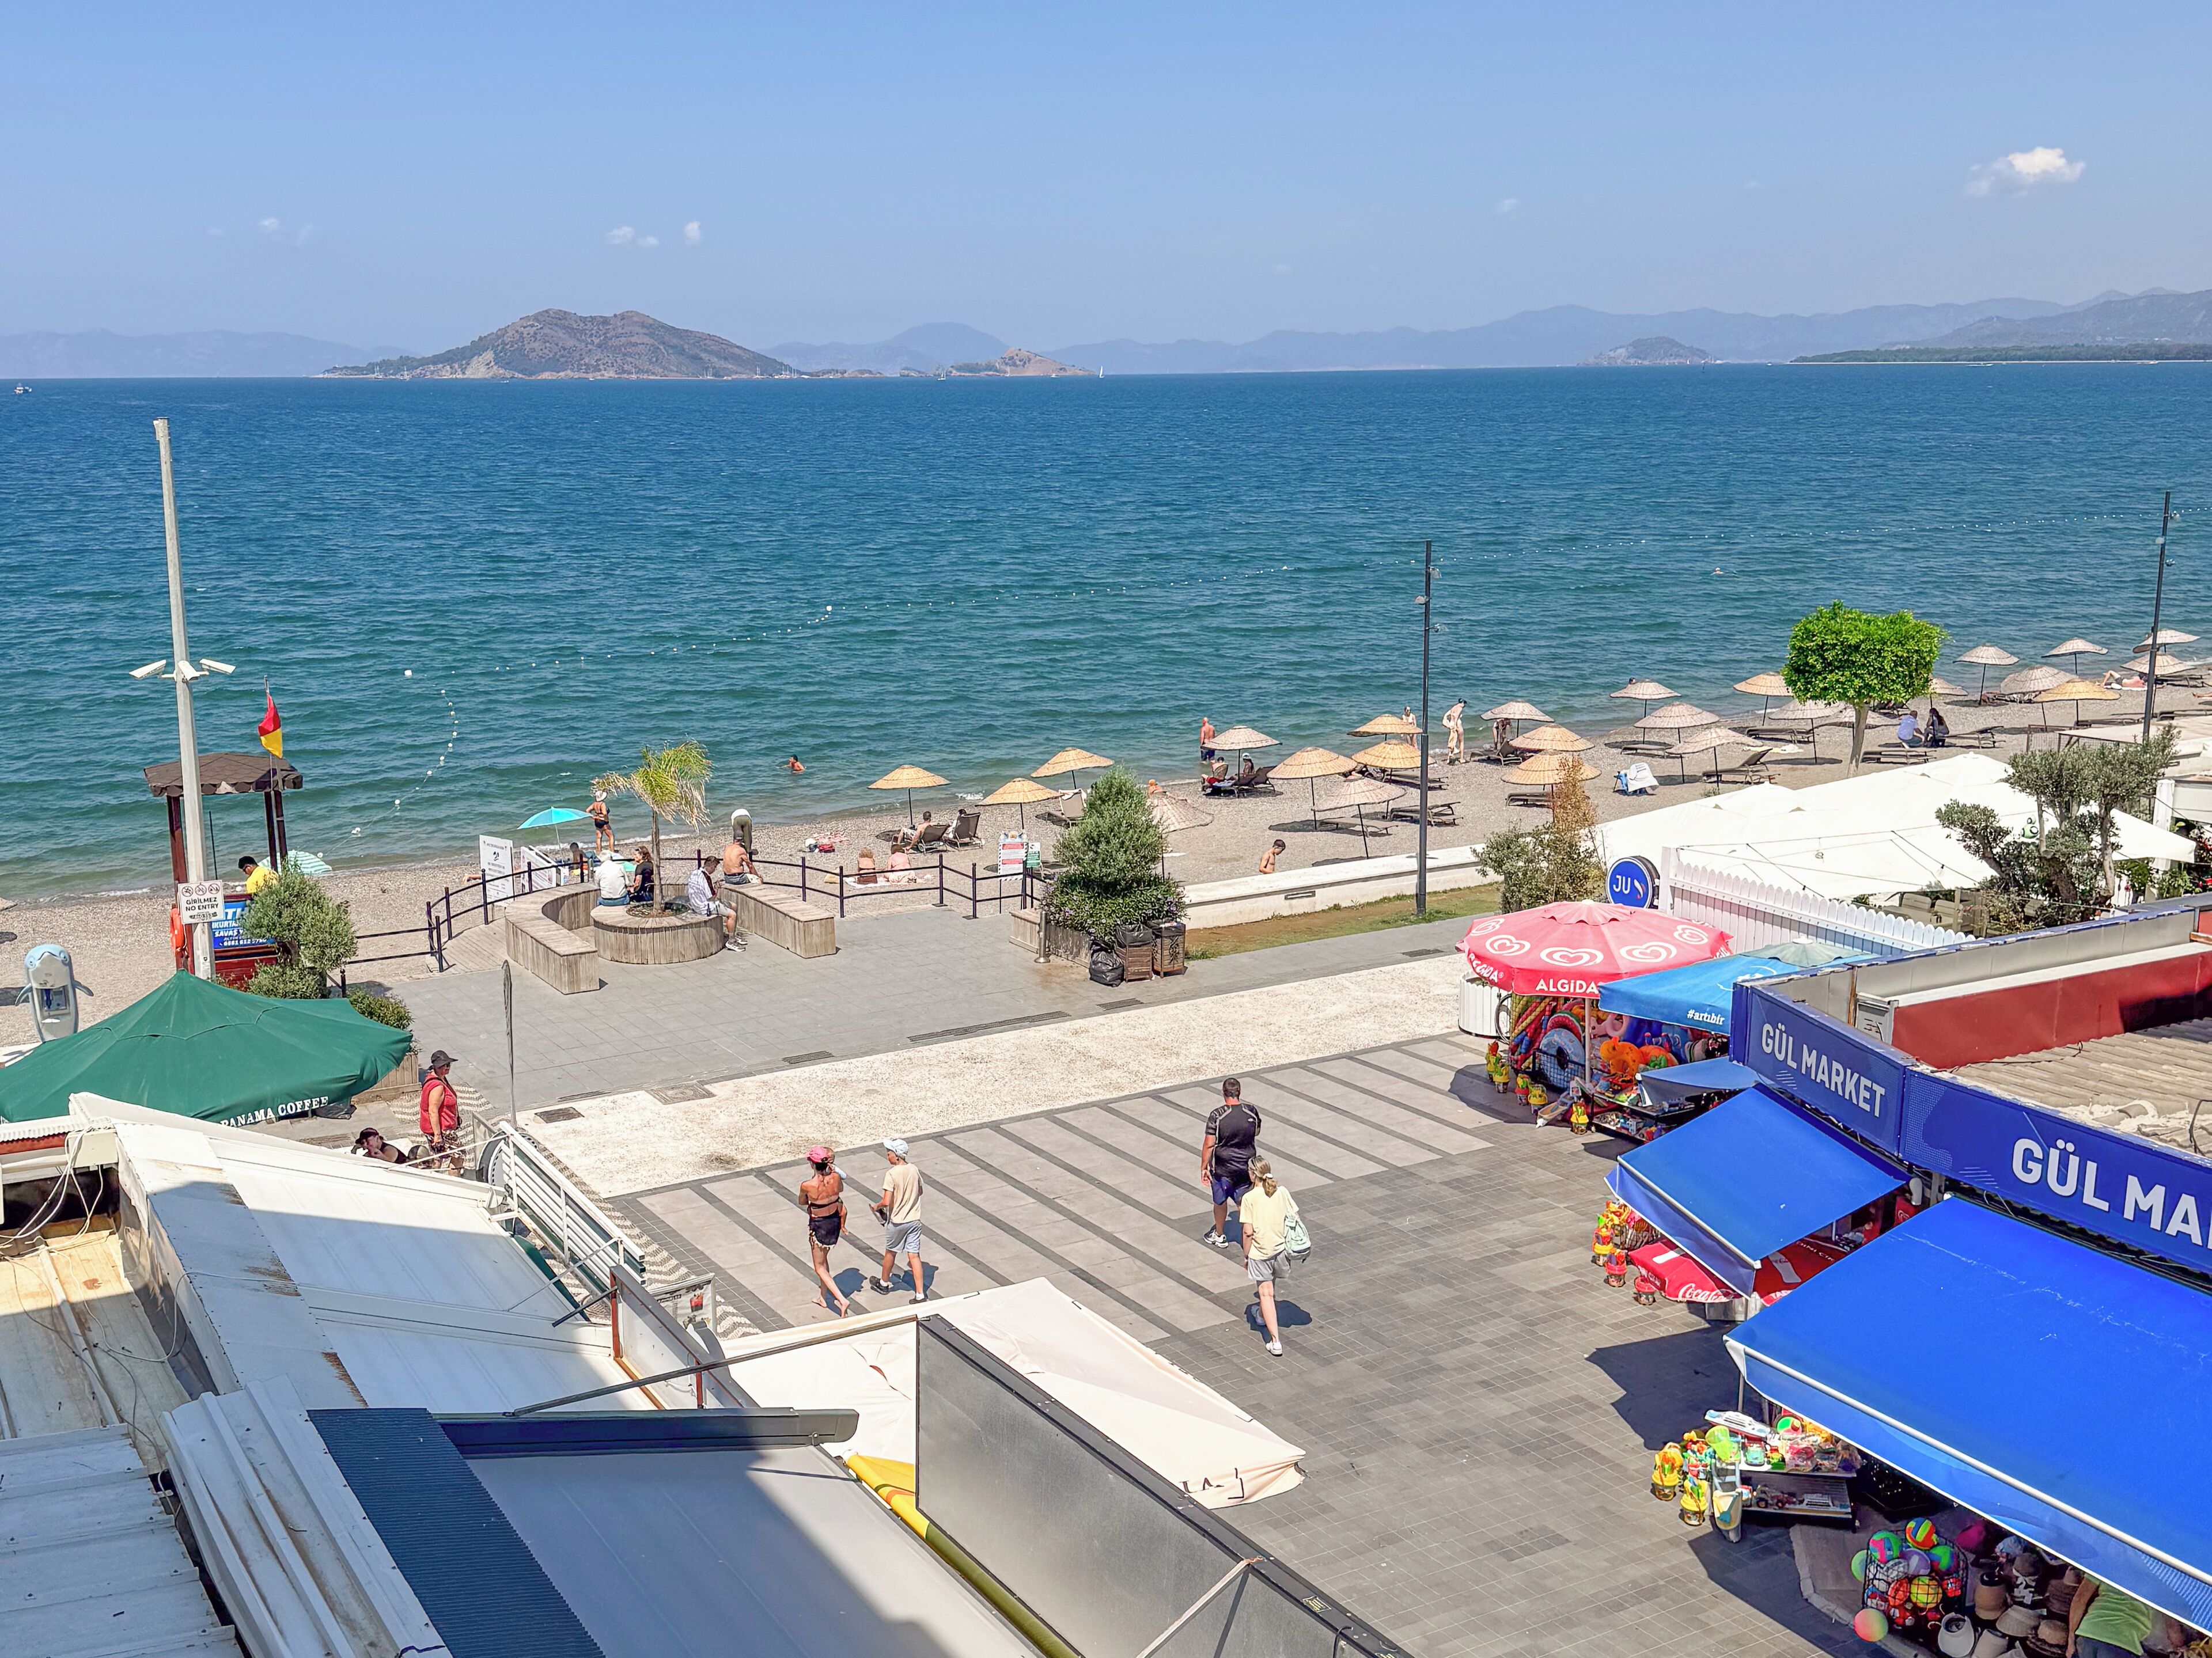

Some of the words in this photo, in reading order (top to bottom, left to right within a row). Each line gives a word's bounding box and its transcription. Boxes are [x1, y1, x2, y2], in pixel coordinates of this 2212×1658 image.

[186, 897, 217, 905] GİRİLMEZ
[1762, 1022, 1797, 1069] GÜL
[1801, 1044, 1885, 1118] MARKET
[278, 1096, 328, 1116] COFFEE
[2012, 1138, 2109, 1212] GÜL
[2123, 1174, 2212, 1250] MA
